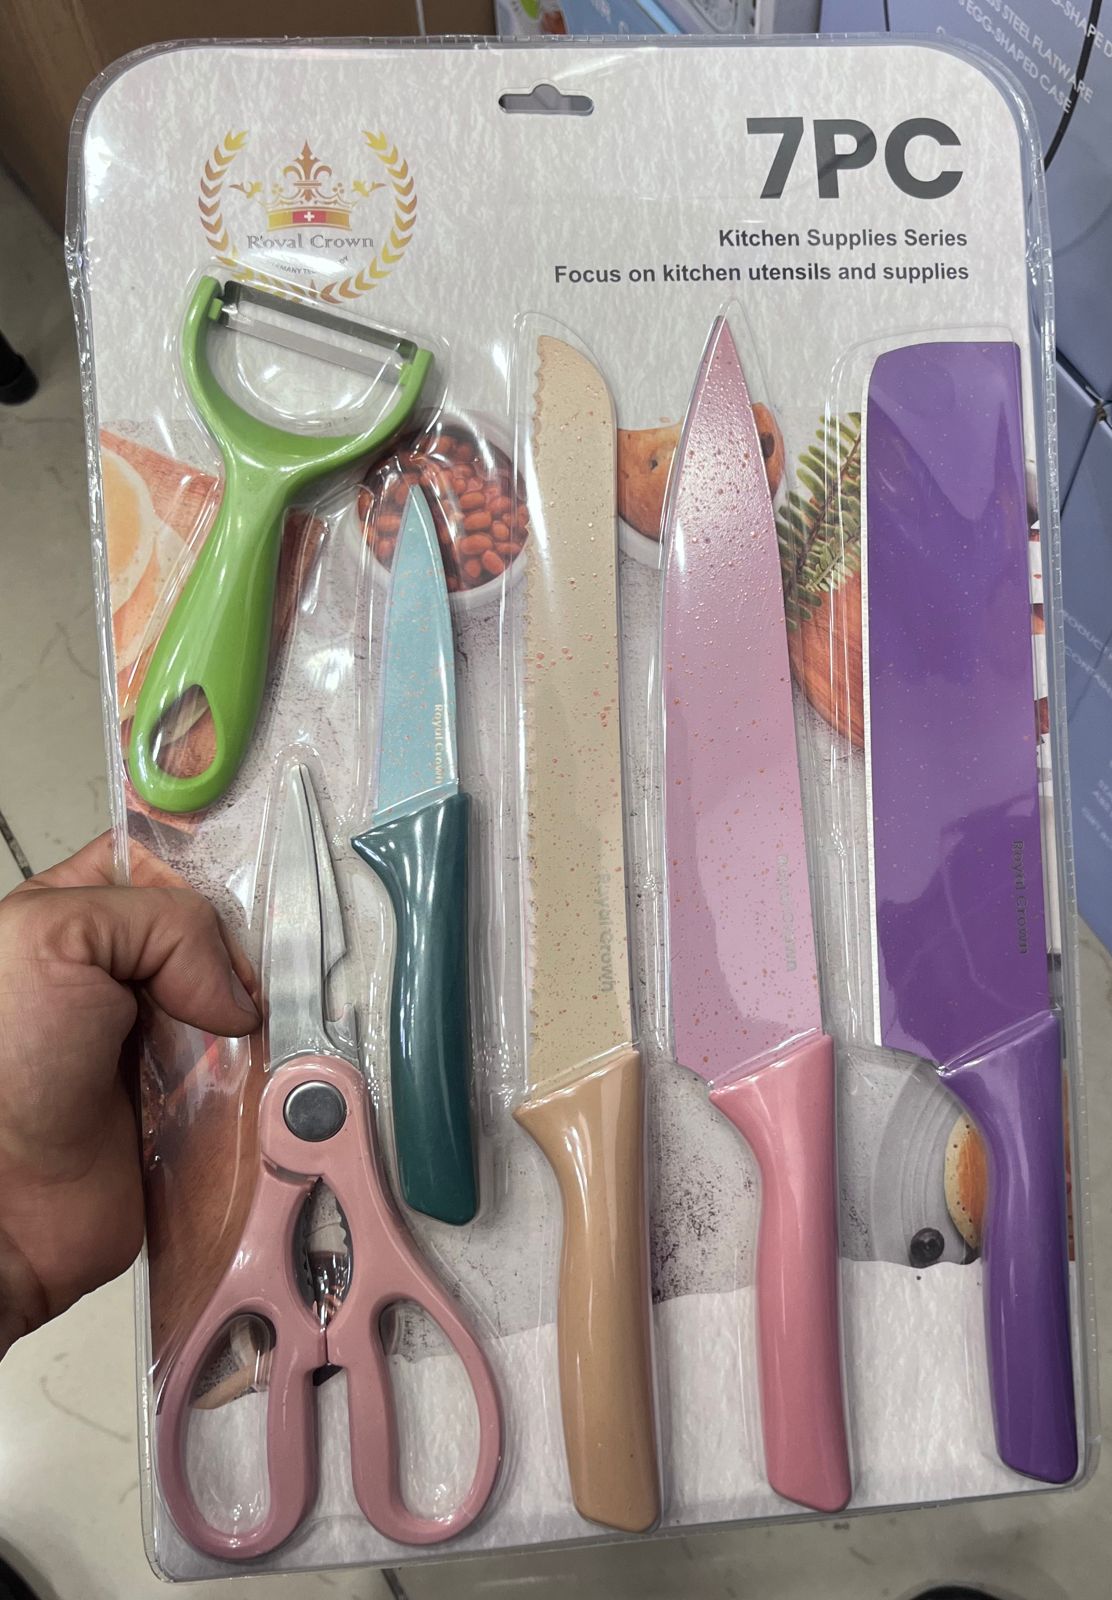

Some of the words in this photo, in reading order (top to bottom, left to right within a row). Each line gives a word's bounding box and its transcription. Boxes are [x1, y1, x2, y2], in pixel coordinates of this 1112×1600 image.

[966, 0, 1039, 79] EGG-SHAPED
[1040, 74, 1072, 114] CASE
[1002, 4, 1031, 44] STEEL
[1032, 35, 1094, 104] FLATWARE
[746, 117, 963, 199] 7PC
[310, 234, 374, 249] Crown
[719, 229, 800, 246] Kitchen
[807, 229, 897, 250] Supplies
[904, 229, 968, 246] Series
[555, 265, 621, 282] Focus
[629, 268, 655, 282] on
[663, 264, 741, 282] kitchen
[749, 263, 831, 280] utensils
[838, 263, 876, 280] and
[883, 263, 969, 283] supplies
[432, 704, 443, 740] Royal
[435, 742, 444, 784] Crown
[1017, 896, 1028, 954] Crown
[600, 930, 615, 992] Crown
